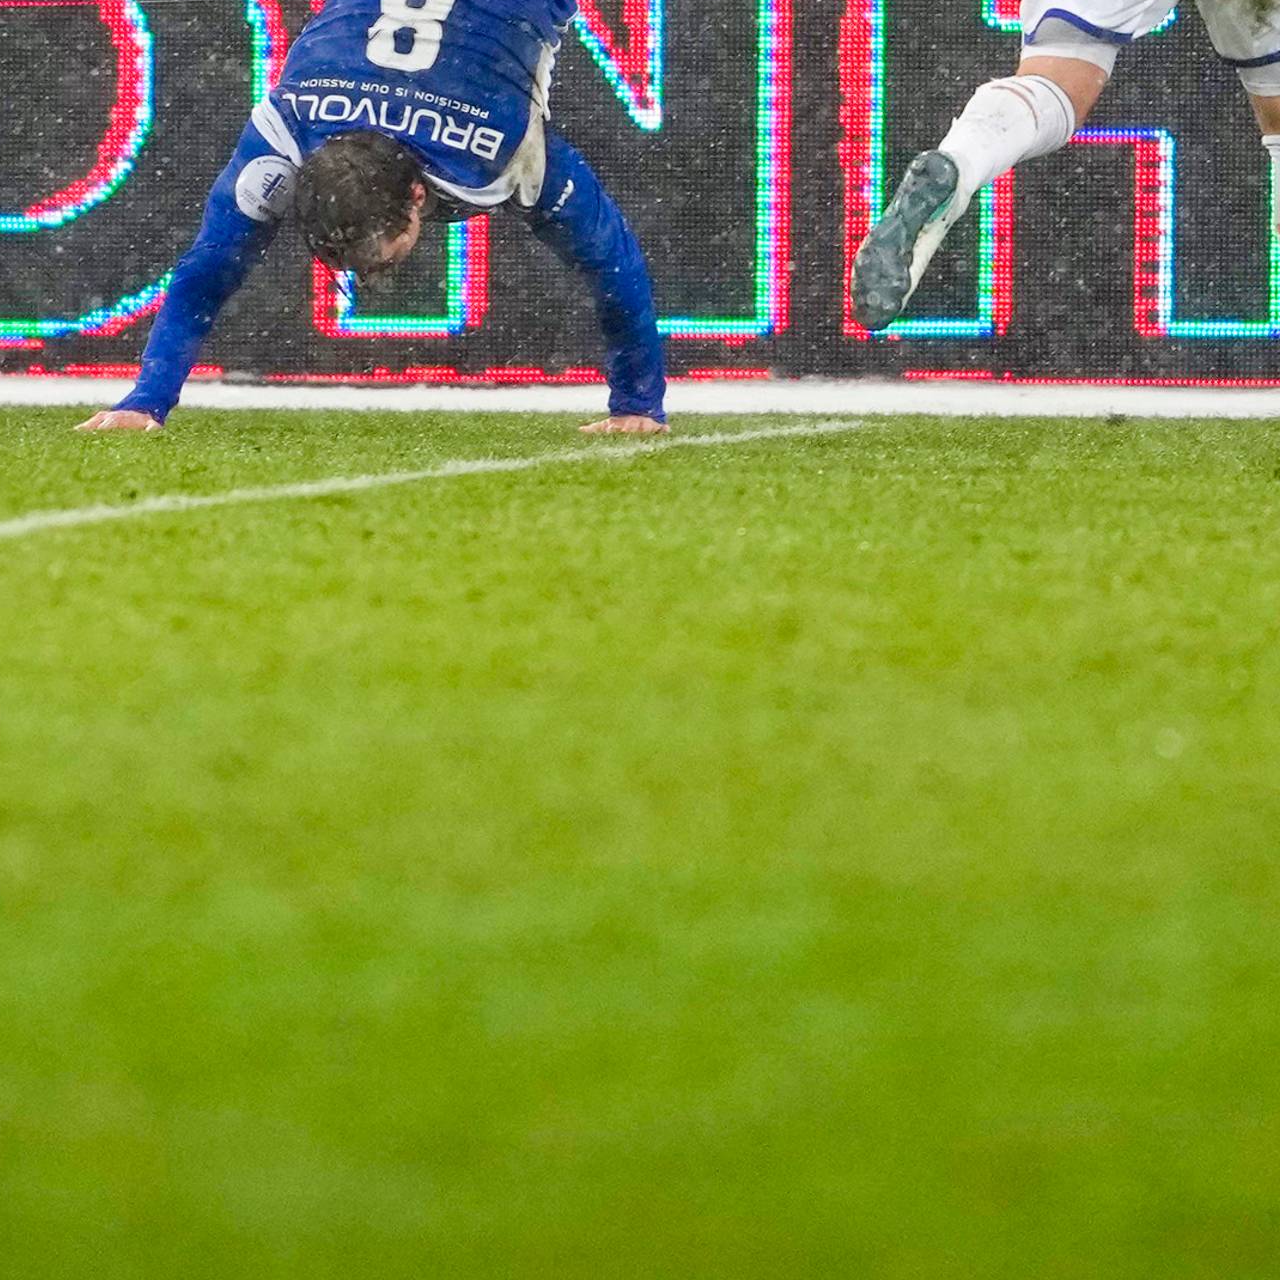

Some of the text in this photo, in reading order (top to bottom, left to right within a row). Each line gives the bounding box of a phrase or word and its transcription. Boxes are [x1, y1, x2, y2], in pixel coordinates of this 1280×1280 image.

[281, 92, 505, 161] BRUNVOLL
[299, 78, 490, 120] PRECISION IS OUR PASSION
